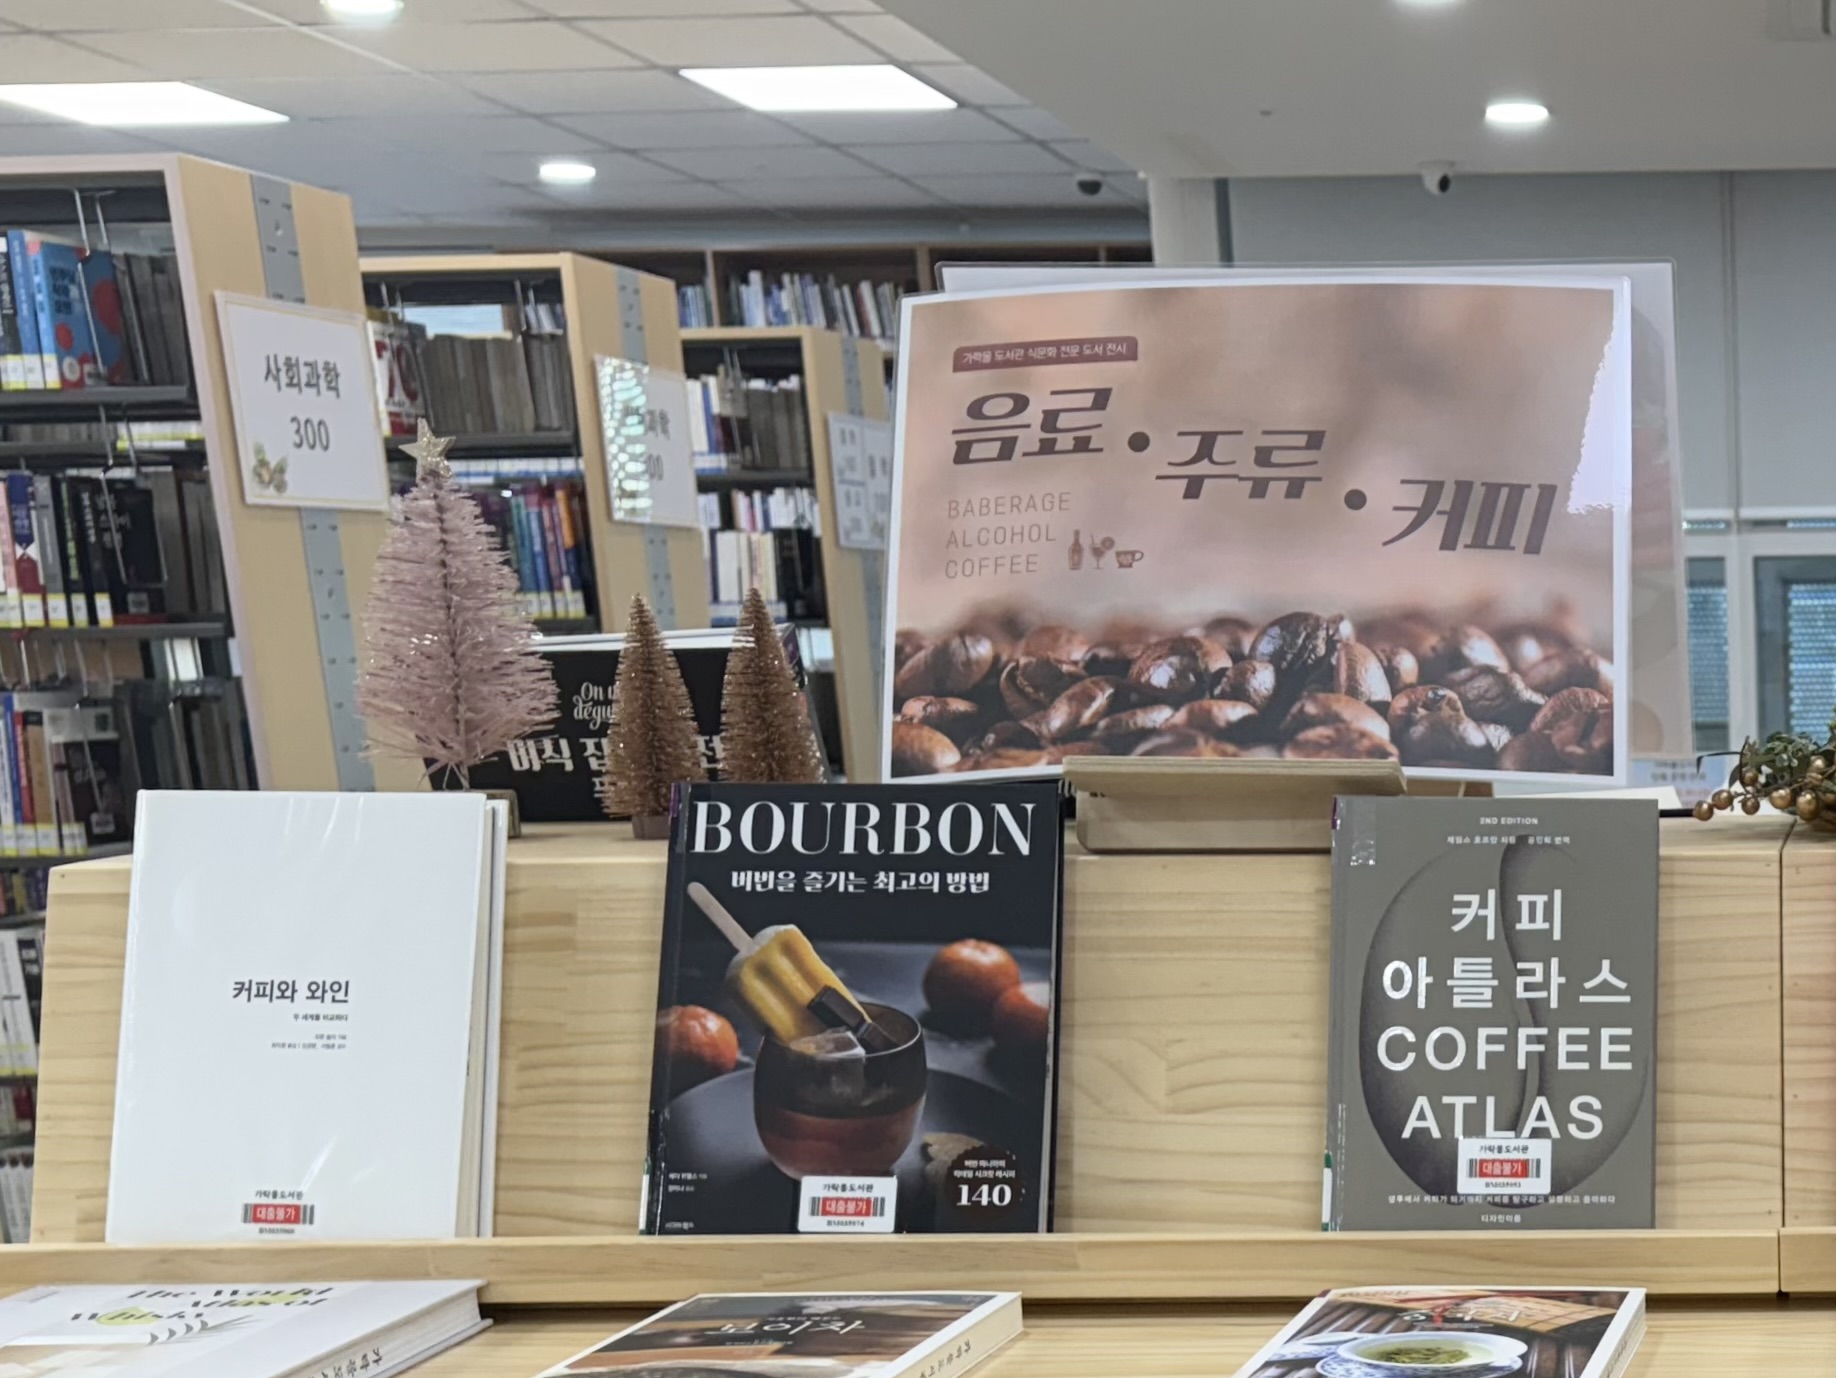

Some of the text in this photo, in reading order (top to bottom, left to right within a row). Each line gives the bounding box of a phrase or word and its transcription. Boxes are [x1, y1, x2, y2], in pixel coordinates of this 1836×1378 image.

[963, 341, 1127, 365] 가락몰 도서관 식문화 전문 도서 전시
[264, 354, 340, 398] 사회과학
[290, 416, 329, 451] 300
[951, 388, 1557, 555] 음료 주류 커피
[948, 493, 1071, 520] BABERAGE
[945, 522, 1057, 548] ALCOHOL
[944, 554, 1039, 579] COFFEE
[581, 682, 603, 700] On
[690, 800, 1037, 856] BOURBON
[1480, 817, 1538, 825] 2ND EDITION
[731, 870, 990, 893] 버번을 즐기는 최고의 방법
[232, 979, 349, 1003] 커피와 와인
[1382, 957, 1631, 1009] 아틀라스
[1377, 1026, 1633, 1070] COFFEE
[1401, 1095, 1604, 1139] ATLAS
[1479, 1145, 1529, 1153] 가락몰도서관
[1482, 1161, 1522, 1175] 대출불가
[823, 1183, 873, 1192] 가락몰도서관
[956, 1184, 1011, 1206] 140
[256, 1207, 296, 1221] 대출불가
[826, 1201, 868, 1214] 대출불가
[704, 1319, 865, 1336] 보이차
